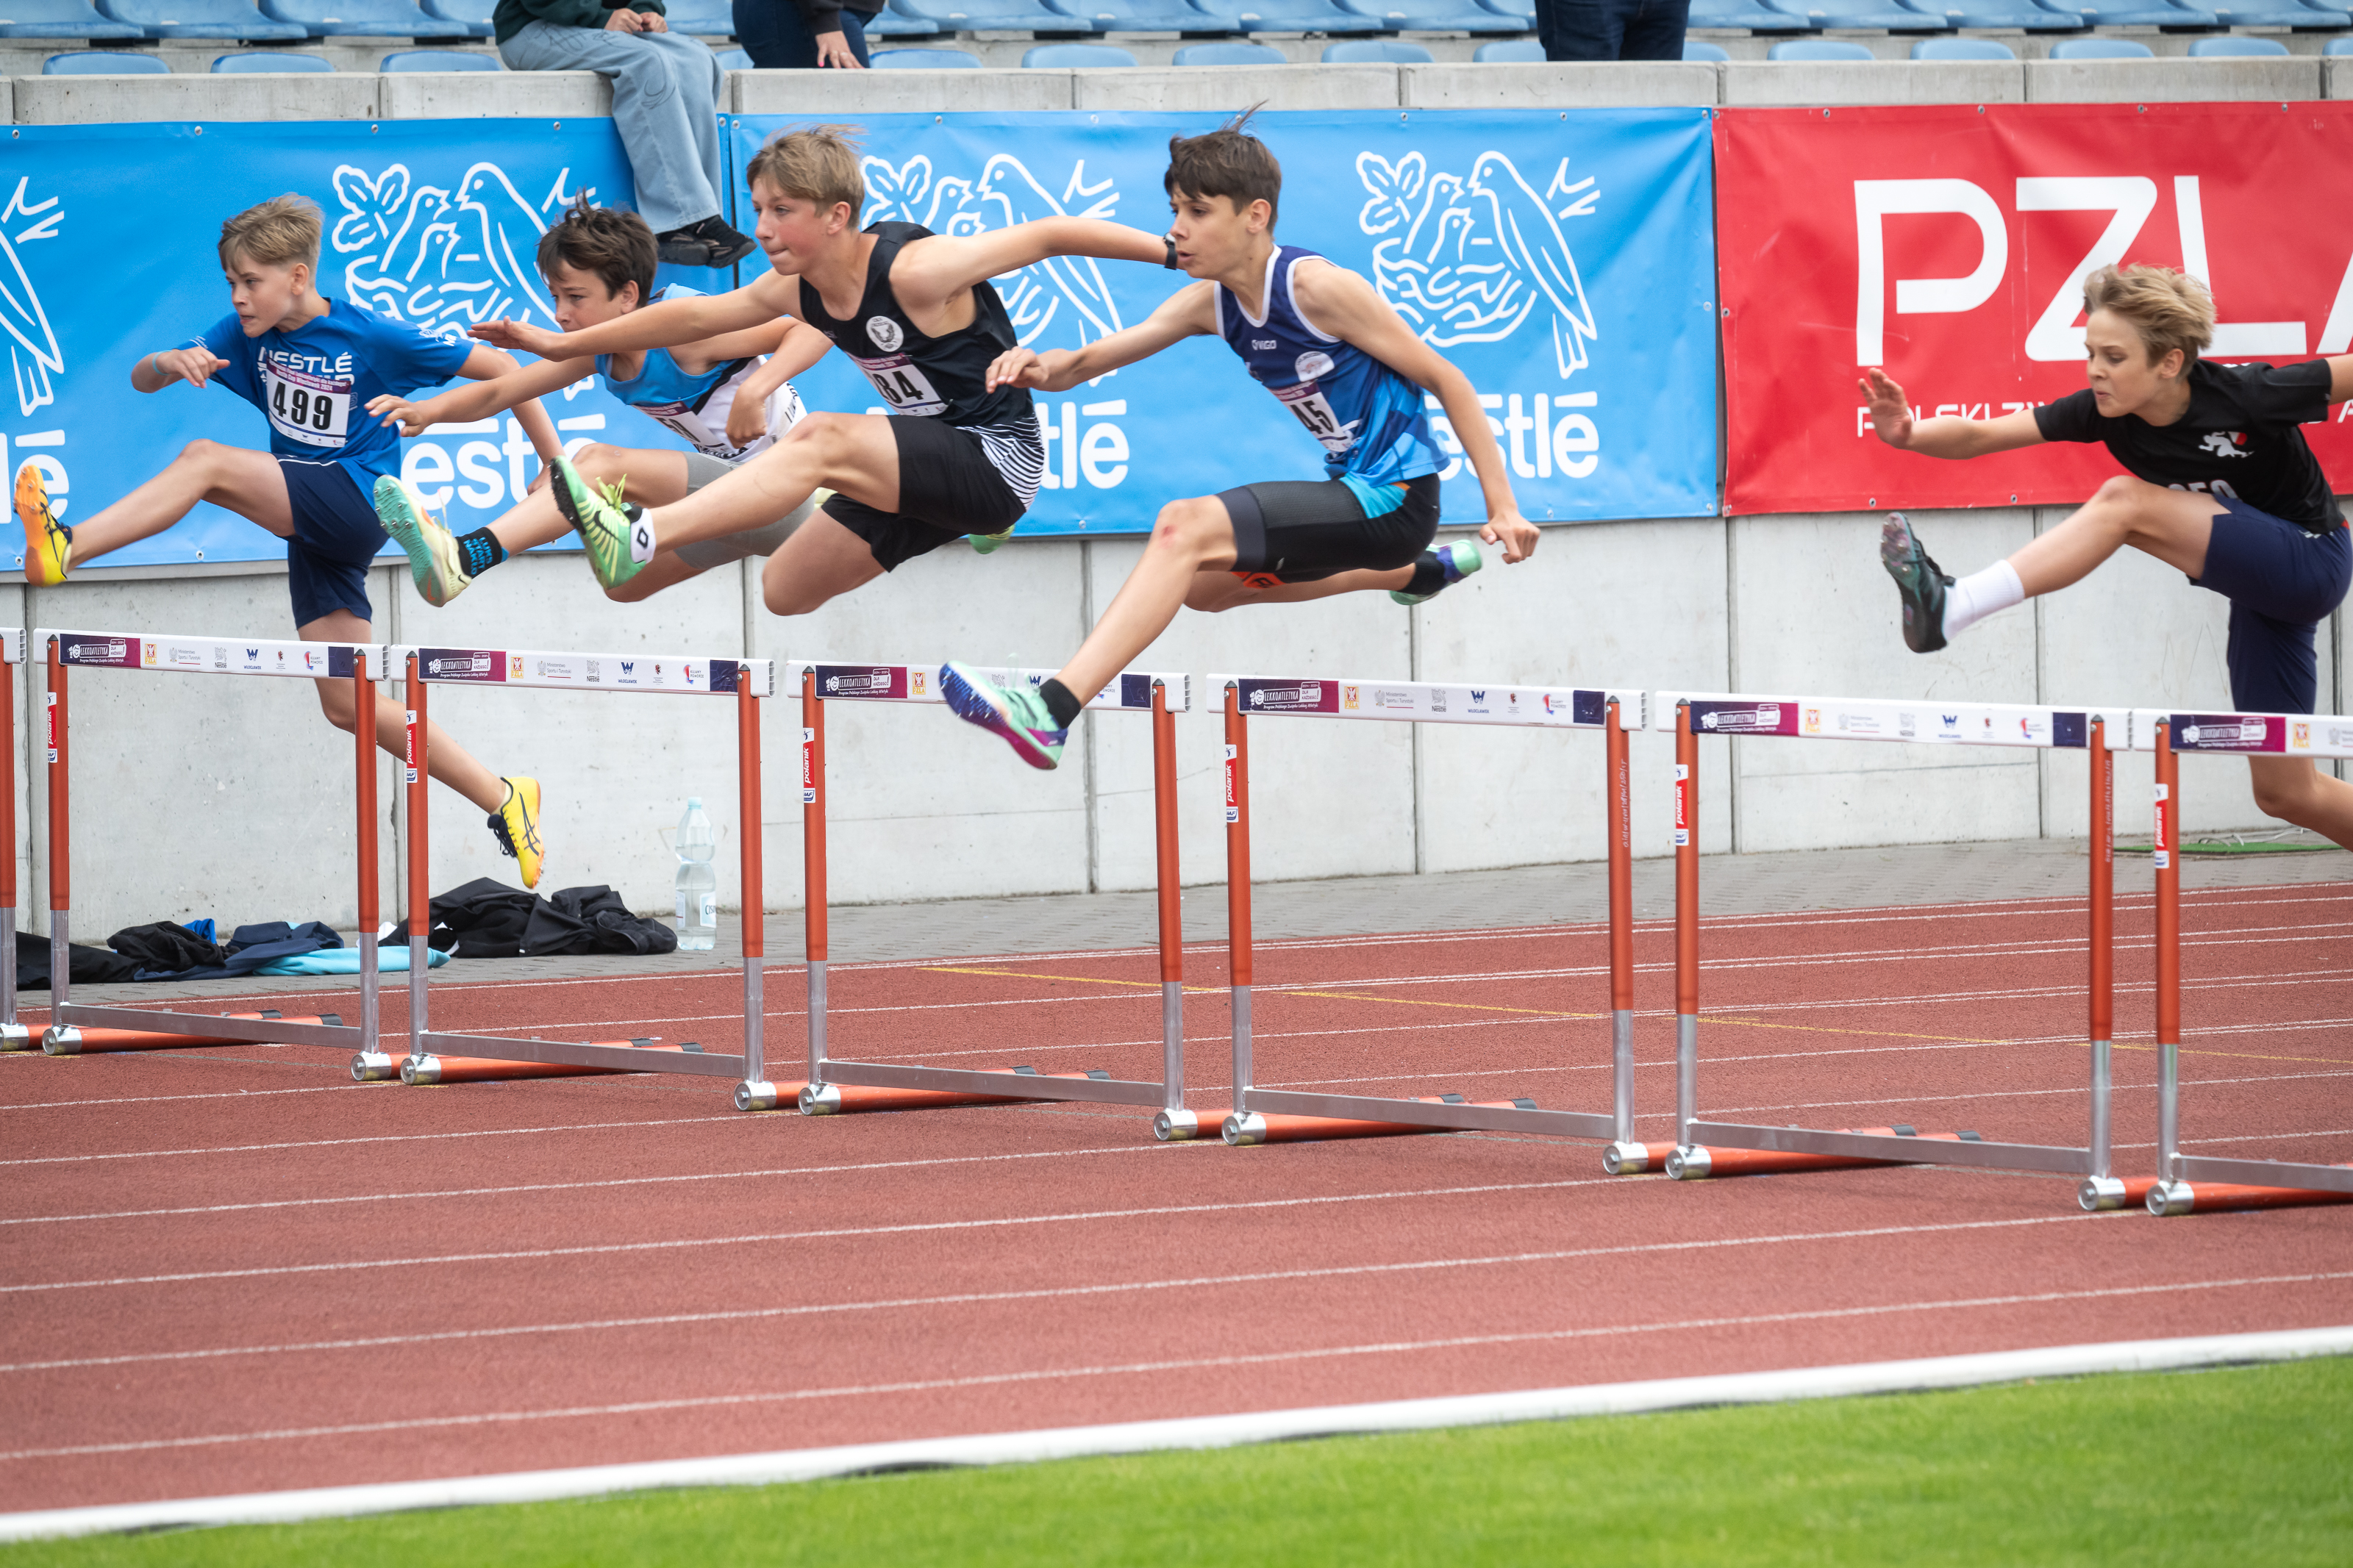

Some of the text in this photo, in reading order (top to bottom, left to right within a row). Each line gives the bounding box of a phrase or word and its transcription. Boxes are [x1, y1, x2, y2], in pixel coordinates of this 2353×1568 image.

[1854, 175, 2353, 366] PZL
[257, 346, 352, 373] NESTLÉ
[868, 370, 924, 404] 84
[273, 381, 332, 431] 499
[1290, 400, 1335, 434] 45
[471, 538, 485, 569] START
[1265, 691, 1299, 701] LEKKOATLETYKA
[804, 747, 812, 784] polanik
[1226, 764, 1235, 803] polanik
[1676, 785, 1685, 825] polanik
